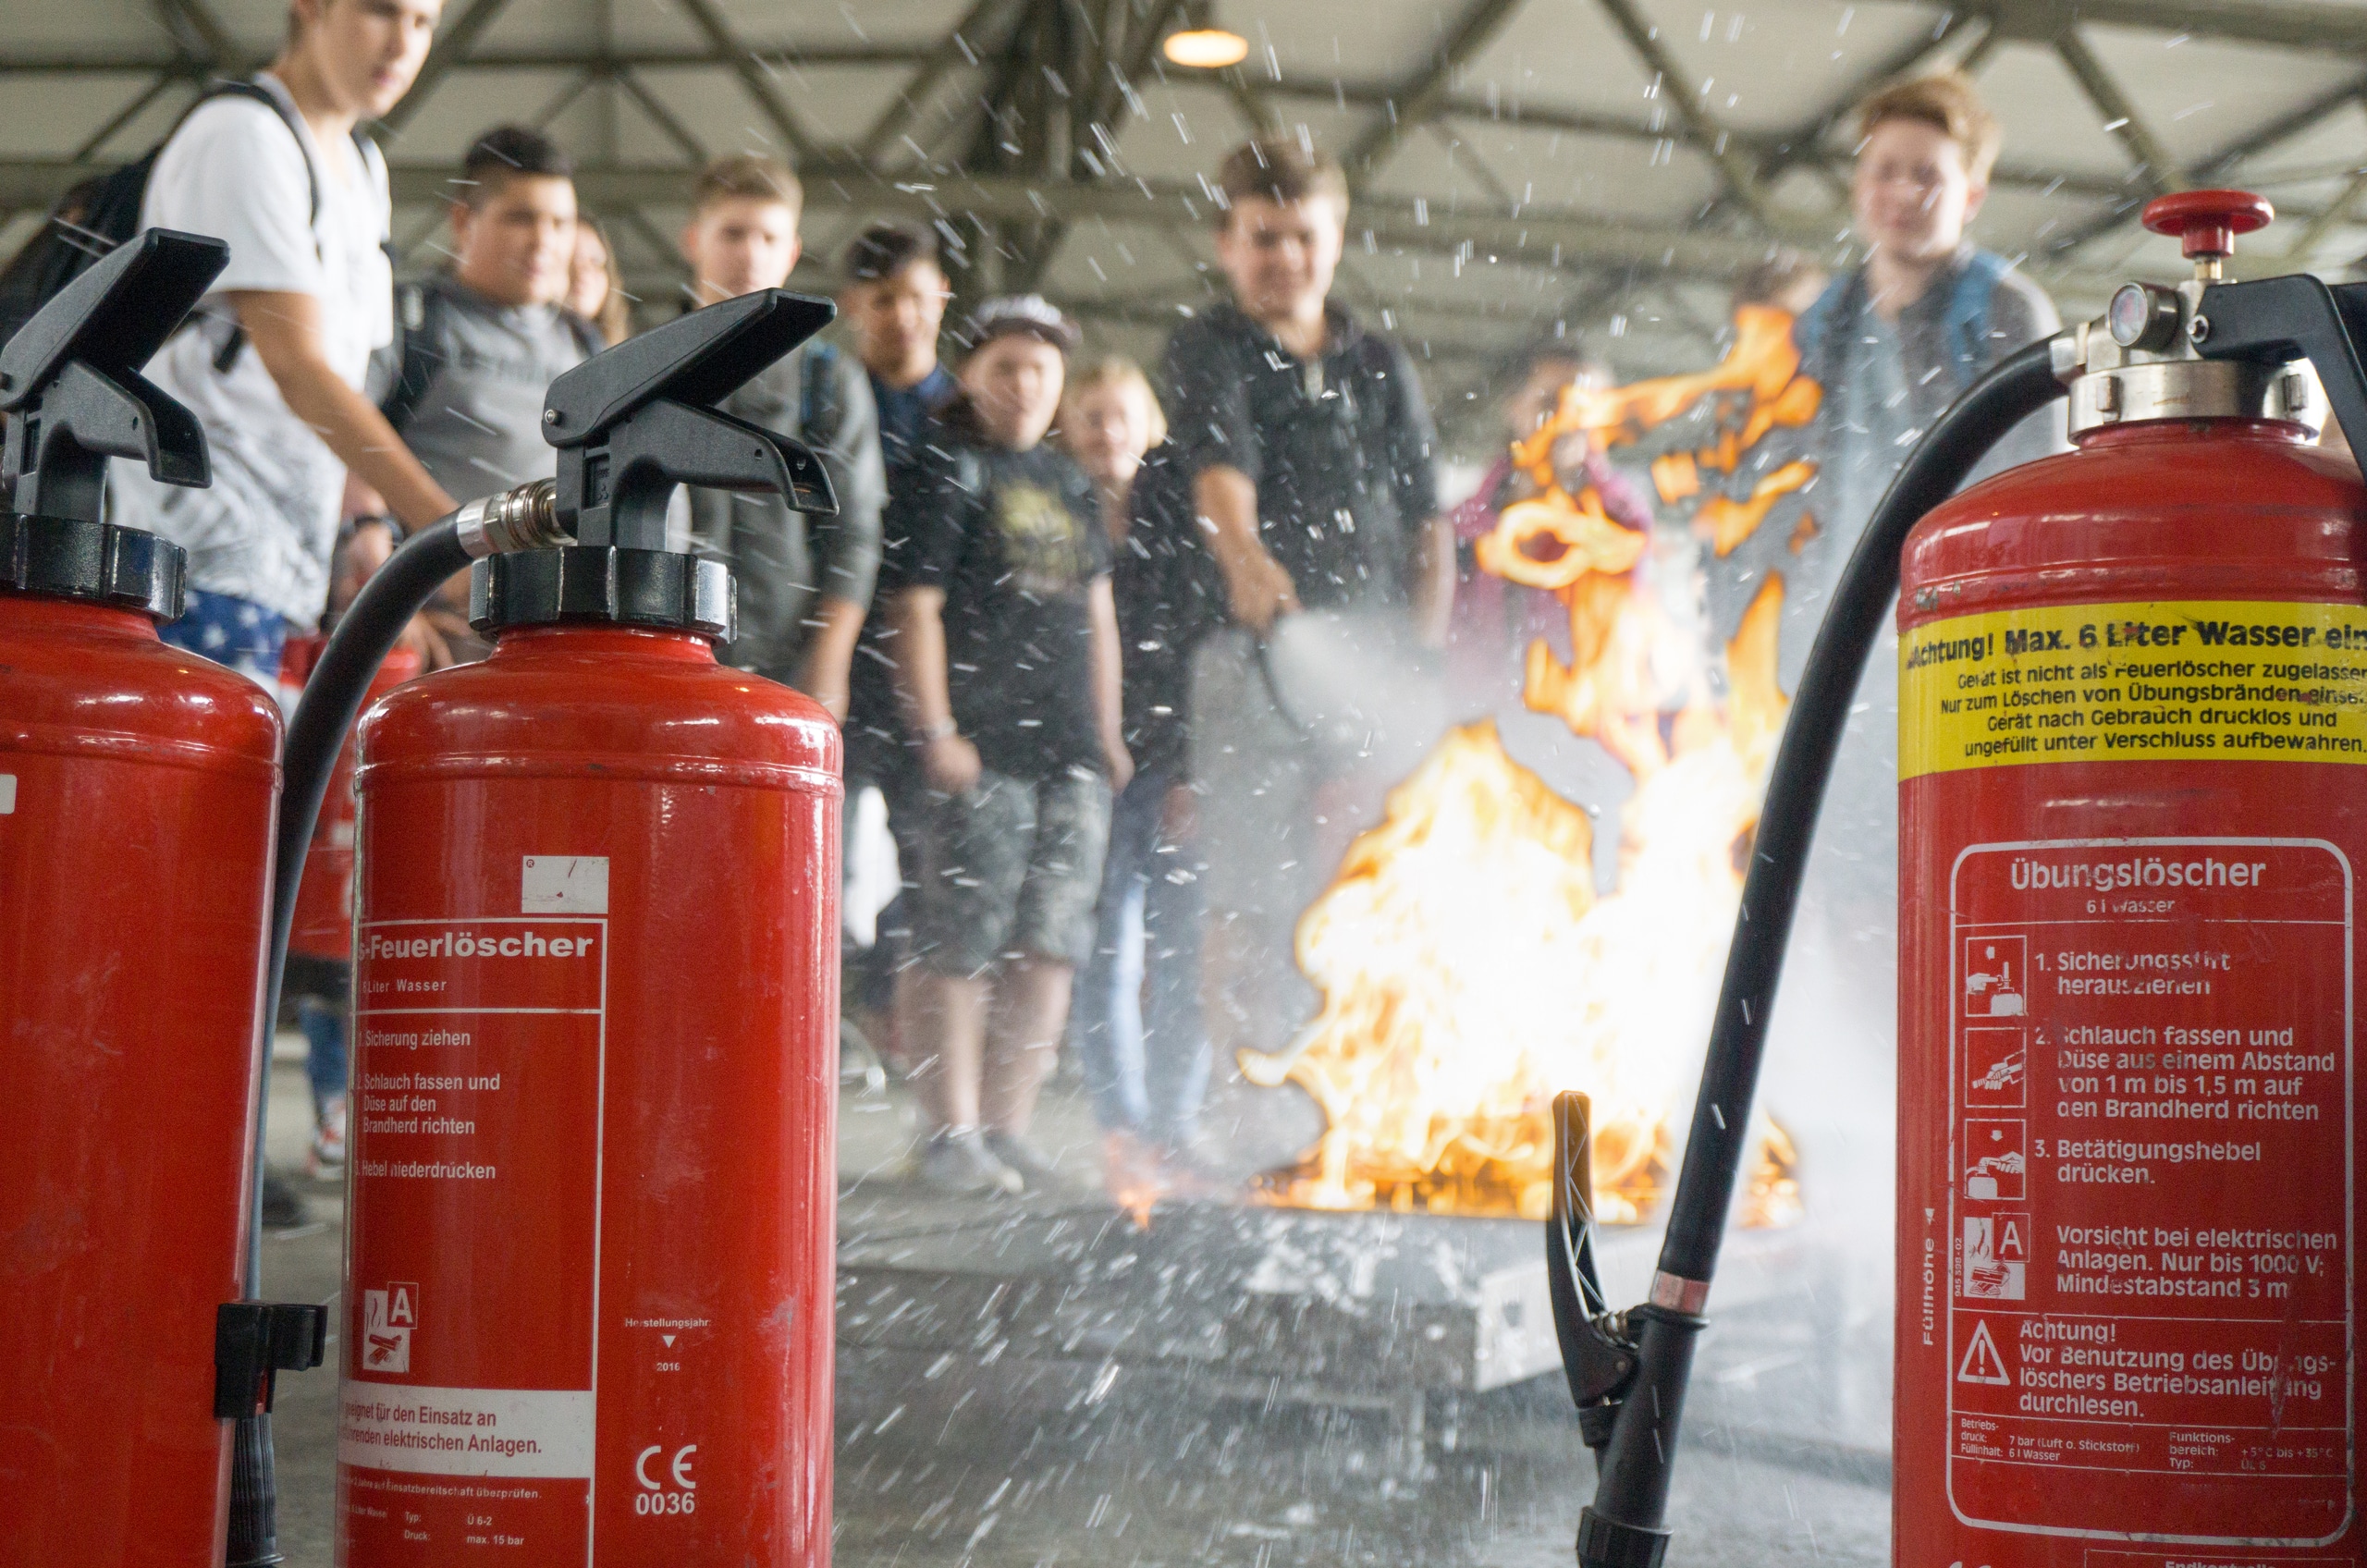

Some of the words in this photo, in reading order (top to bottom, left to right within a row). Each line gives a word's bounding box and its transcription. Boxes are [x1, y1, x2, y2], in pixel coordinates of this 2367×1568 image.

[1907, 632, 1993, 669] Achtung!
[2005, 629, 2071, 655] Max.
[2079, 624, 2098, 648] 6
[2197, 621, 2316, 647] Wasser
[2002, 668, 2021, 685] ist
[2027, 664, 2075, 682] nicht
[2080, 663, 2107, 680] als
[1941, 698, 1962, 715] Nur
[1966, 694, 1997, 711] zum
[2004, 689, 2077, 708] Löschen
[2082, 687, 2121, 703] von
[2128, 682, 2300, 704] Übungsbränden
[1988, 712, 2033, 731] Gerät
[2038, 710, 2085, 729] nach
[2091, 708, 2192, 726] Gebrauch
[2200, 707, 2292, 726] drucklos
[2300, 712, 2337, 728] und
[1965, 735, 2039, 757] ungefüllt
[2044, 734, 2098, 751] unter
[2104, 731, 2216, 749] Verschluss
[2223, 731, 2367, 753] aufbewahren.
[2011, 857, 2266, 891] Übungslöscher
[2086, 900, 2097, 913] 6
[2035, 952, 2051, 971] 1.
[368, 981, 390, 993] Liter
[397, 979, 447, 992] Wasser
[365, 1030, 418, 1050] Sicherung
[422, 1029, 471, 1046] ziehen
[2035, 1026, 2051, 1045] 2.
[2164, 1025, 2241, 1046] fassen
[2249, 1027, 2293, 1047] und
[2058, 1049, 2110, 1070] Düse
[2116, 1052, 2156, 1070] aus
[2163, 1050, 2235, 1070] einem
[2241, 1051, 2336, 1072] Abstand
[363, 1073, 411, 1090] Schlauch
[414, 1072, 462, 1090] fassen
[469, 1073, 500, 1090] und
[2058, 1076, 2100, 1094] von
[2105, 1074, 2116, 1094] 1
[2125, 1077, 2146, 1094] m
[2154, 1074, 2188, 1095] bis
[2193, 1074, 2226, 1097] 1,5
[2234, 1078, 2256, 1095] m
[2264, 1076, 2303, 1096] auf
[363, 1095, 386, 1111] Düse
[389, 1095, 409, 1111] auf
[411, 1095, 436, 1112] den
[2105, 1098, 2229, 1120] Brandherd
[2238, 1100, 2319, 1121] richten
[363, 1117, 418, 1133] Brandherd
[422, 1117, 475, 1134] richten
[2035, 1139, 2051, 1158] 3.
[2057, 1139, 2261, 1163] Betätigungshebel
[362, 1160, 387, 1177] Hebel
[390, 1160, 496, 1179] niederdrücken
[2057, 1163, 2156, 1184] drücken.
[1999, 1220, 2023, 1256] A
[2056, 1225, 2149, 1246] Vorsicht
[2154, 1227, 2189, 1247] bei
[2196, 1228, 2337, 1249] elektrischen
[2057, 1249, 2153, 1273] Anlagen.
[2162, 1252, 2204, 1272] Nur
[2210, 1253, 2243, 1272] bis
[2249, 1254, 2300, 1274] 1000
[1923, 1238, 1935, 1346] Füllhöhe
[2056, 1273, 2241, 1297] Mindestabstand
[2248, 1279, 2261, 1298] 3
[2267, 1280, 2288, 1298] m
[390, 1287, 413, 1324] A
[2019, 1320, 2116, 1344] Achtung!
[656, 1363, 681, 1371] 2016
[2019, 1343, 2054, 1364] Vor
[2061, 1346, 2184, 1372] Benutzung
[2192, 1350, 2234, 1370] des
[2019, 1367, 2106, 1390] löschers
[376, 1403, 390, 1421] für
[393, 1404, 415, 1423] den
[419, 1405, 472, 1426] Einsatz
[477, 1412, 497, 1427] an
[2019, 1391, 2145, 1417] durchlesen.
[1961, 1418, 1999, 1431] Betriebs-
[384, 1429, 463, 1452] elektrischen
[467, 1434, 542, 1457] Anlagen.
[1960, 1430, 1987, 1443] druck:
[2009, 1436, 2016, 1446] 7
[2017, 1436, 2035, 1447] bar
[2037, 1438, 2063, 1450] (Luft
[2169, 1432, 2236, 1443] Funktions-
[1960, 1444, 2004, 1458] Füllinhalt:
[2009, 1449, 2015, 1458] 6
[2023, 1451, 2061, 1462] Wasser
[2169, 1445, 2219, 1456] bereich:
[2276, 1448, 2294, 1458] bis
[2169, 1458, 2194, 1469] Typ:
[476, 1488, 542, 1499] überprüfen.
[635, 1492, 695, 1515] 0036
[405, 1512, 422, 1523] Typ:
[477, 1516, 492, 1525] 6-2
[404, 1530, 431, 1541] Druck:
[467, 1536, 490, 1545] max.
[493, 1535, 505, 1545] 15
[508, 1536, 524, 1546] bar
